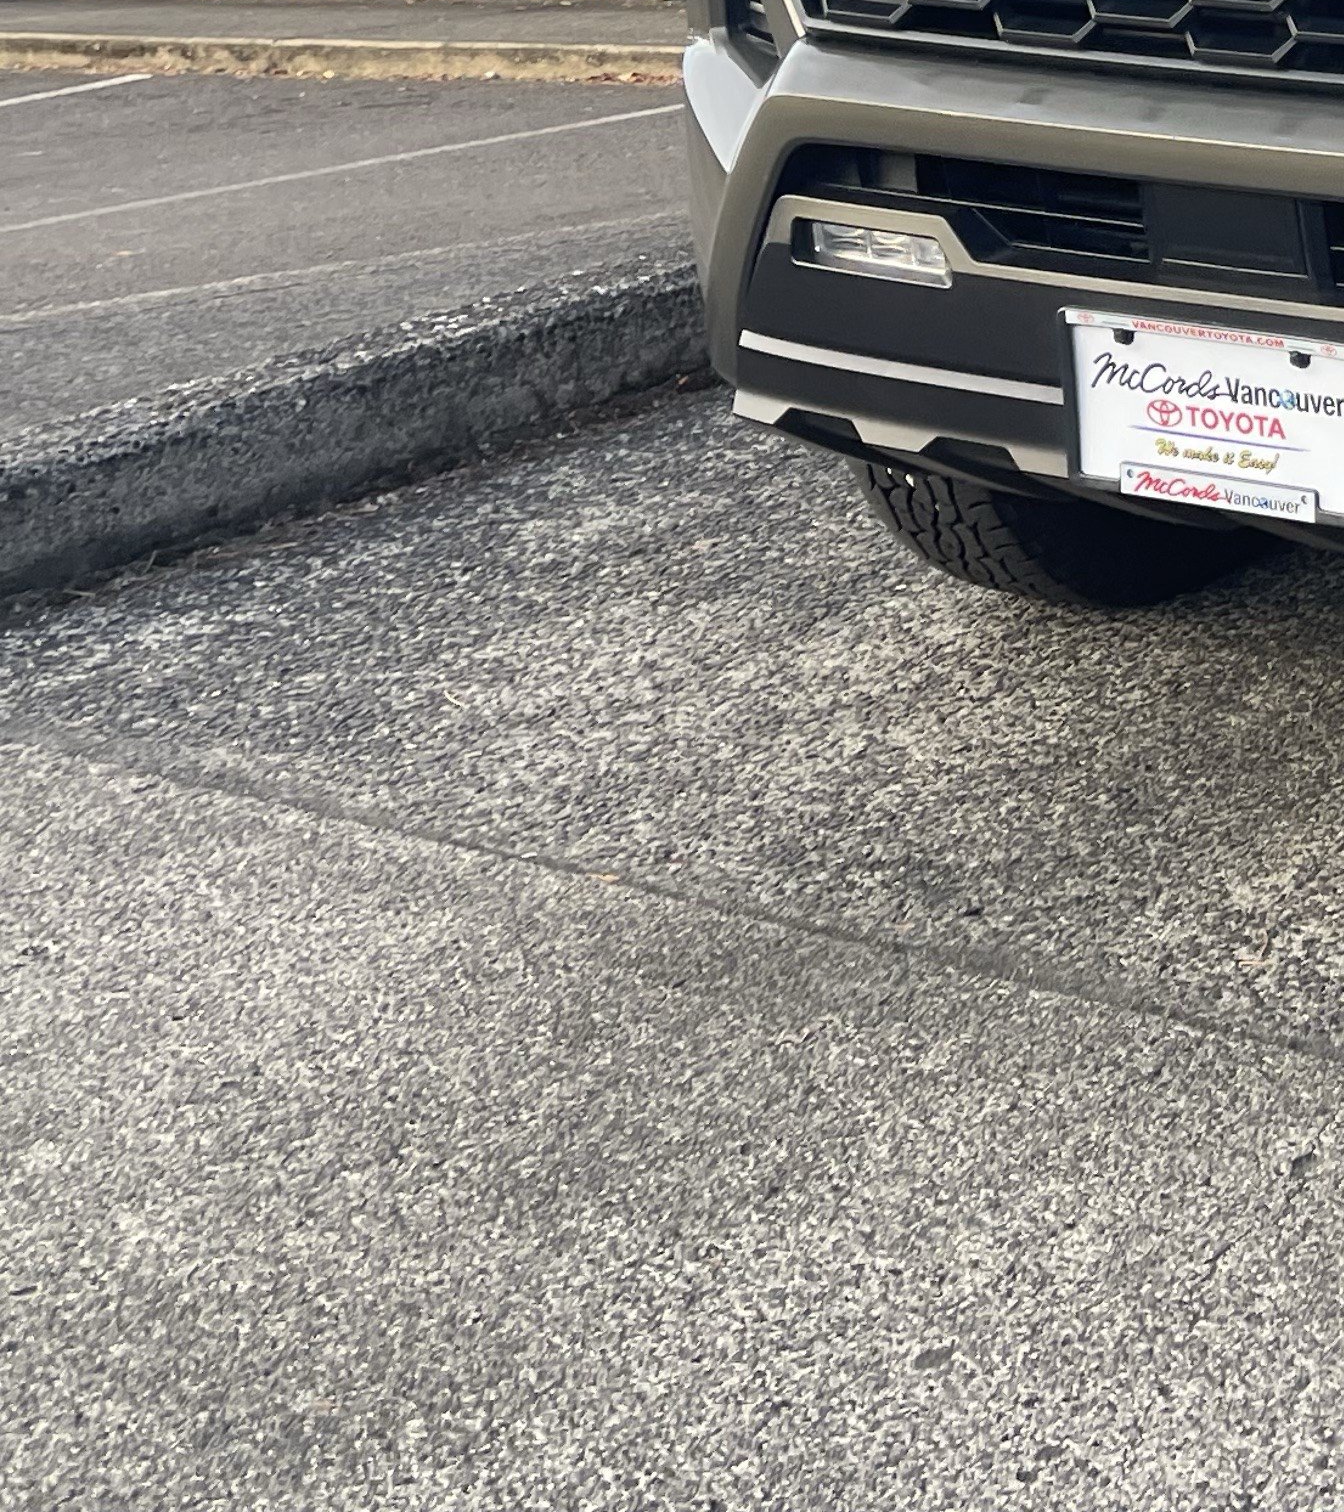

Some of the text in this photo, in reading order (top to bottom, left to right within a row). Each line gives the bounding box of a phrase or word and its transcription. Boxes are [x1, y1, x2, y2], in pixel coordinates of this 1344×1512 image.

[1131, 320, 1285, 348] VANCOUVERTOYOTA.COM
[1186, 405, 1287, 440] TOYOTA
[1155, 437, 1180, 457] We
[1183, 446, 1220, 463] make
